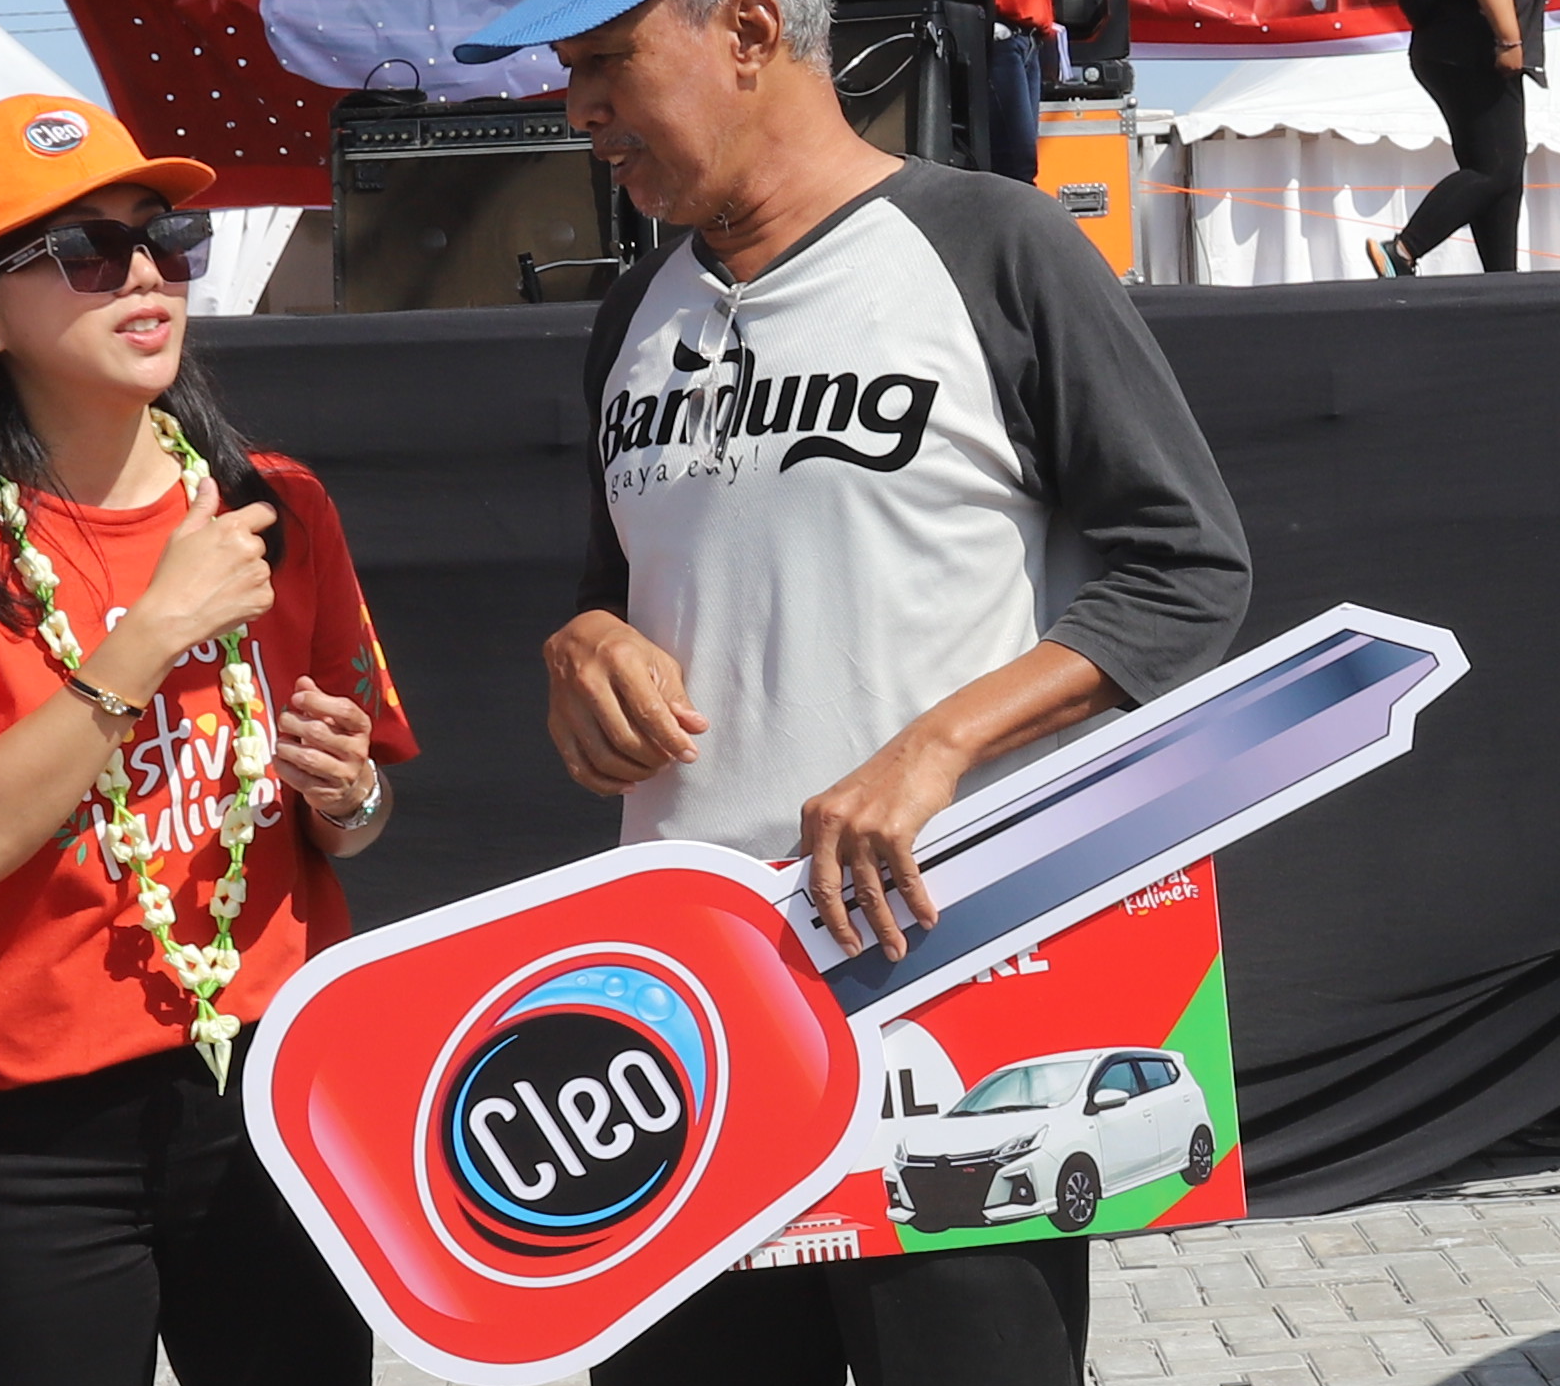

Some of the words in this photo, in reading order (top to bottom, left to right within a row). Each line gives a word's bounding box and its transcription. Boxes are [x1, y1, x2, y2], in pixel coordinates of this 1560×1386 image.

[30, 123, 80, 146] Cleo
[602, 339, 940, 474] Bandung
[610, 461, 669, 504] gaya
[1123, 882, 1196, 916] kuliner
[468, 1048, 686, 1202] Cleo
